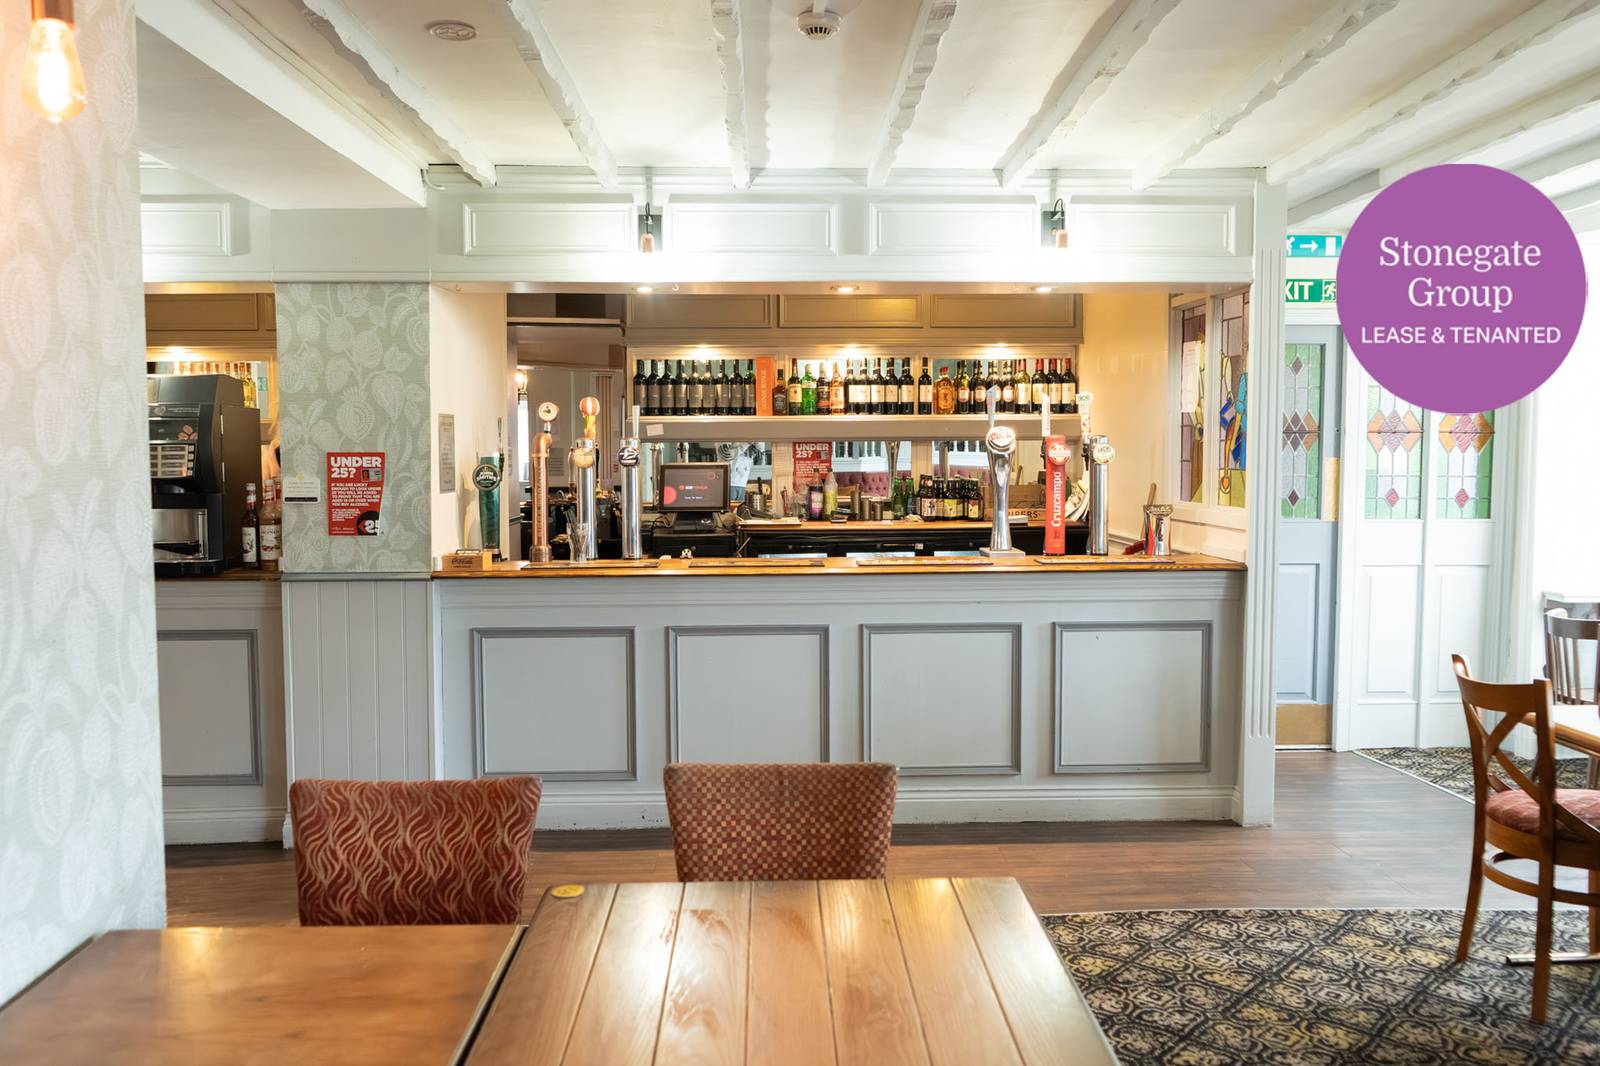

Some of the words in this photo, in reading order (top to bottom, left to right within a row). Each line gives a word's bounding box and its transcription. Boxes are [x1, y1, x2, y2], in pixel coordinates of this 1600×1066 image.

[331, 457, 381, 467] UNDER
[331, 468, 356, 478] 25?
[1051, 471, 1063, 527] Cruzcampo
